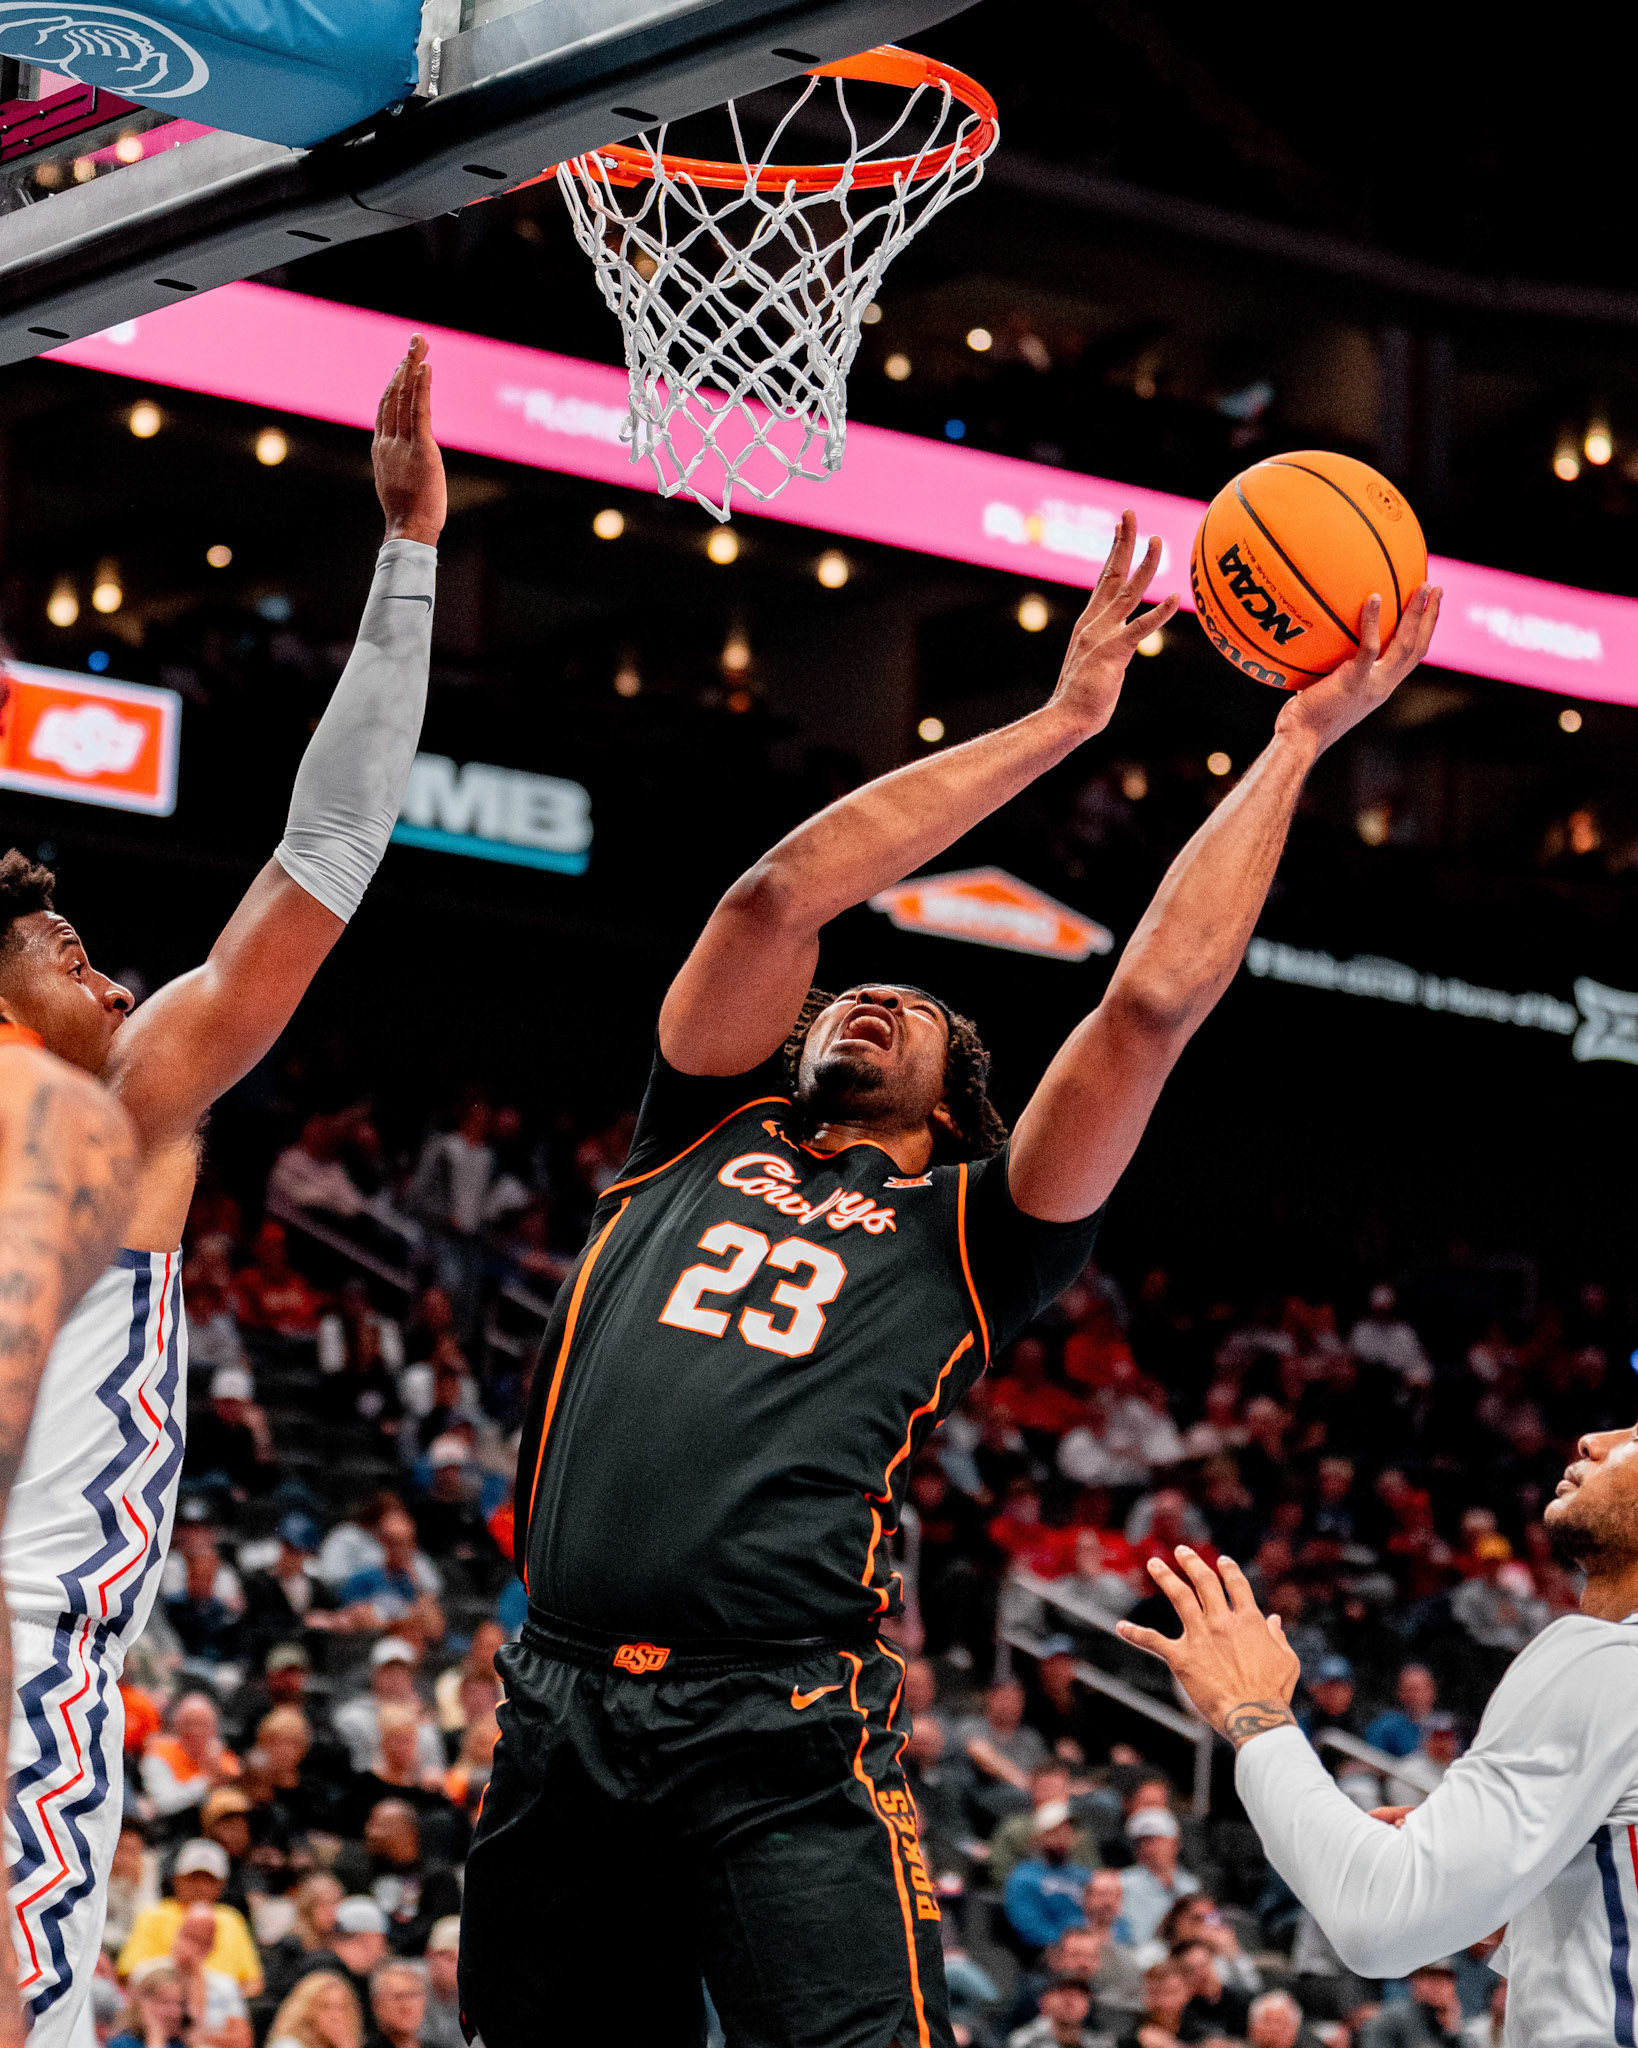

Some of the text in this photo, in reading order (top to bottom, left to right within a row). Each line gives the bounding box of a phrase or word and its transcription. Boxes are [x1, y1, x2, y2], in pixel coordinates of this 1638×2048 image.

[1217, 543, 1307, 645] NCAA
[1242, 537, 1314, 628] OFFICIAL GAME BALL
[398, 751, 594, 854] MB
[658, 1220, 848, 1358] 23
[613, 1642, 671, 1675] OSU
[877, 1790, 942, 1921] POKES
